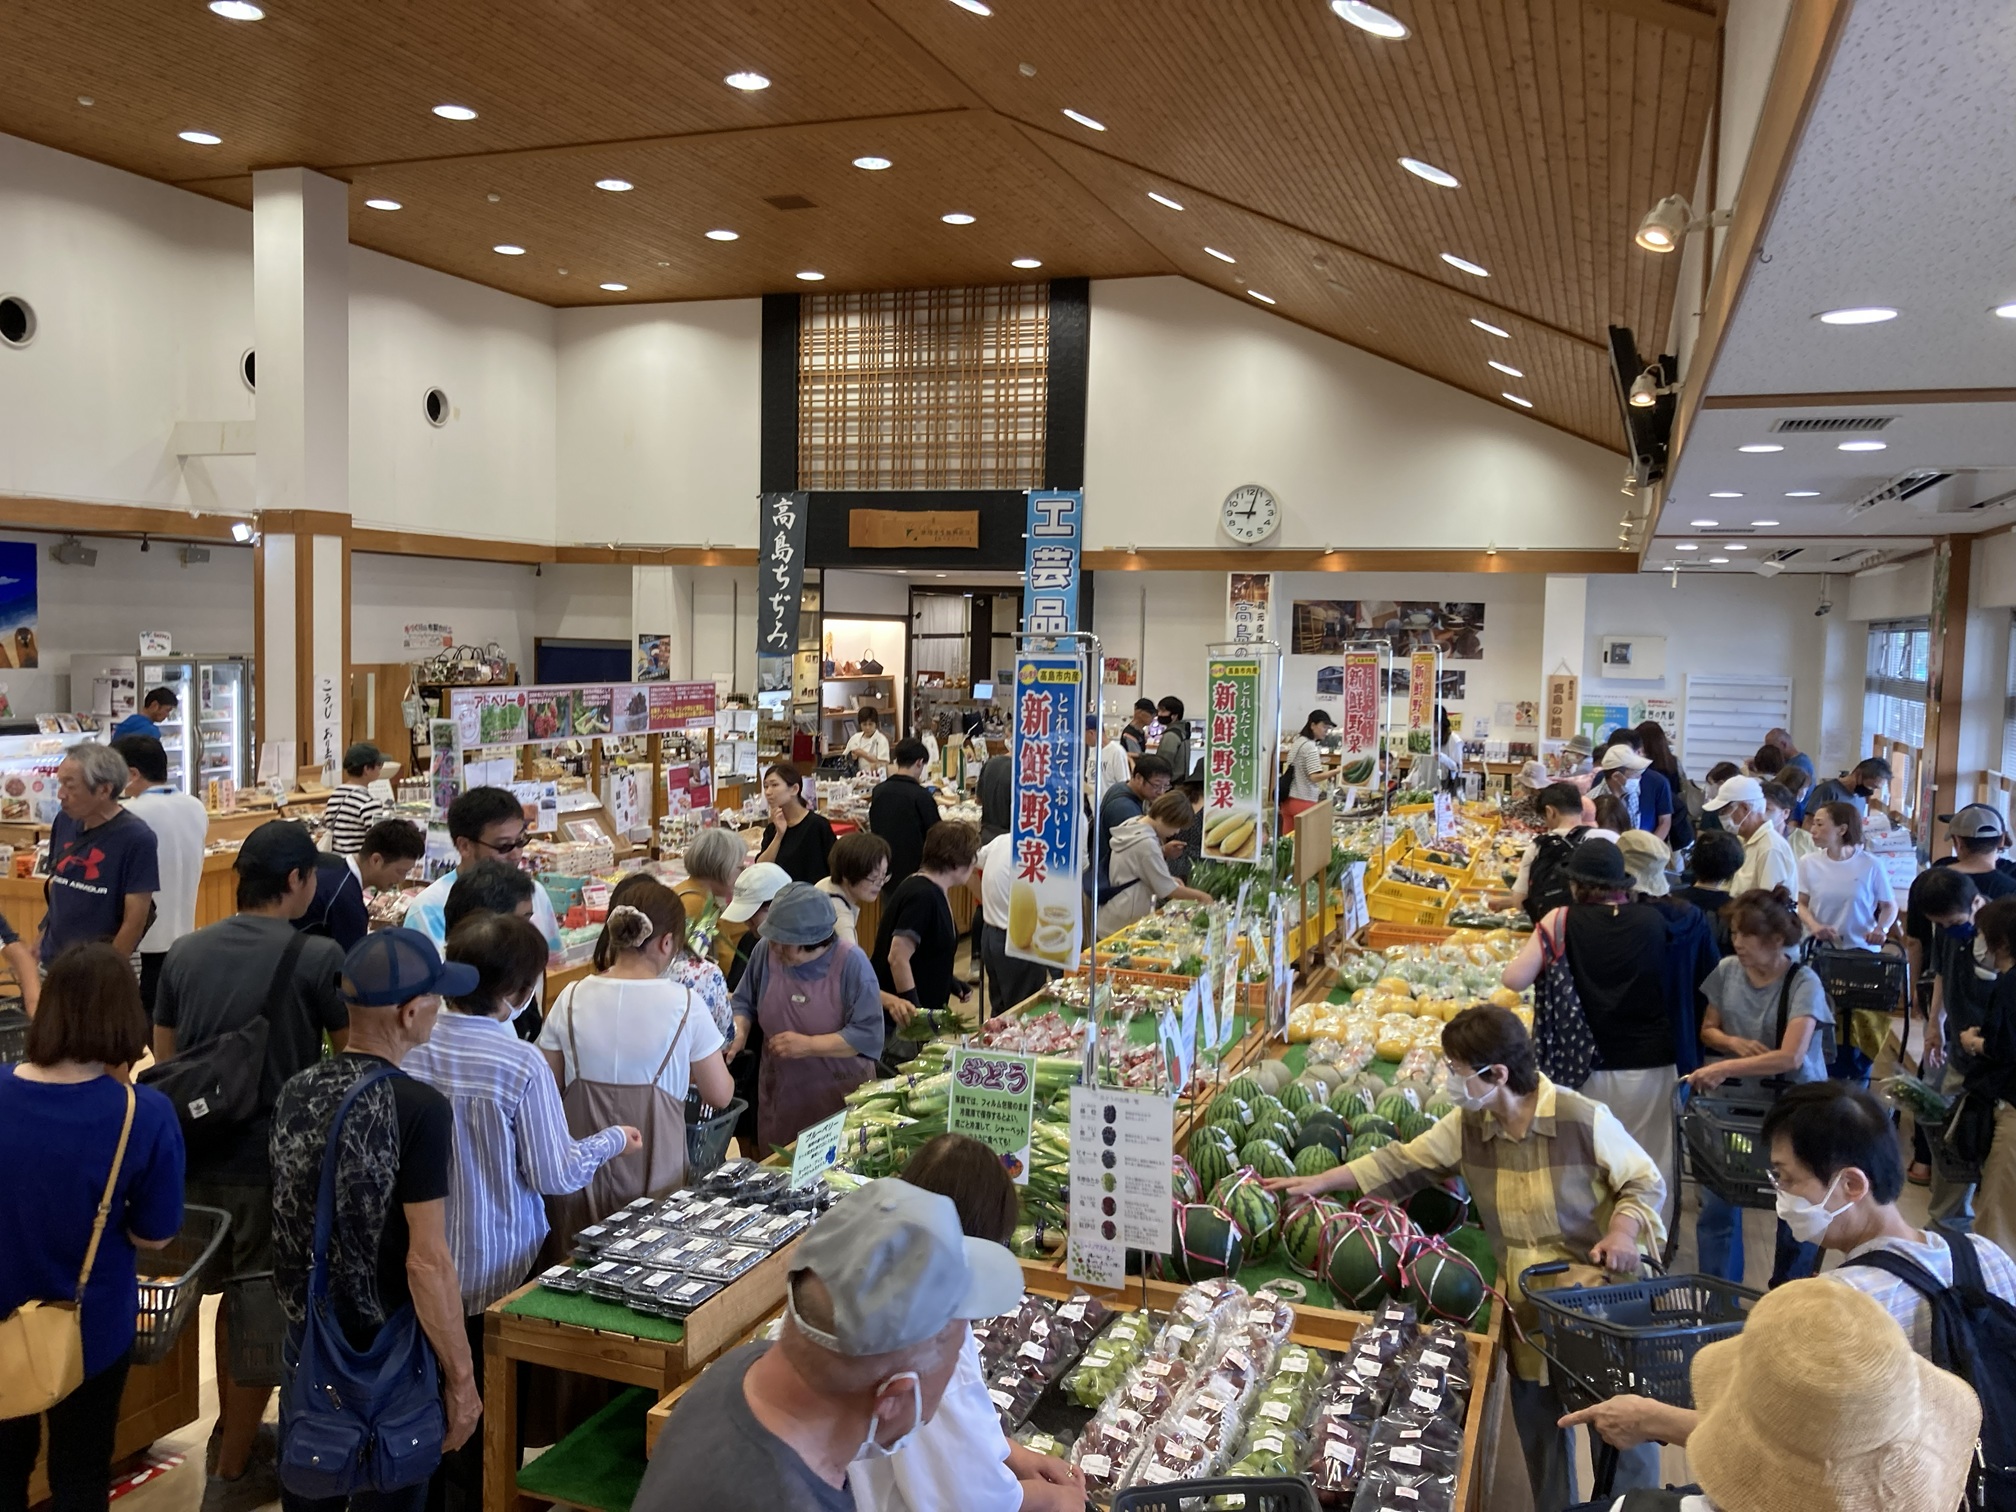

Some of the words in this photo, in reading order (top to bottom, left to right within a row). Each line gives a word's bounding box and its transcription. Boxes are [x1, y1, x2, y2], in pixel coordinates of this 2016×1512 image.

[1229, 500, 1238, 508] 10
[1236, 492, 1244, 500] 11
[1229, 519, 1236, 527] 8
[1267, 509, 1275, 517] 3
[1236, 527, 1243, 535] 7
[1246, 530, 1253, 538] 6
[1256, 527, 1264, 535] 5
[767, 497, 797, 648] 高島ちぢみ
[1029, 498, 1076, 640] 工芸品
[1040, 670, 1080, 682] 高島市内産
[322, 679, 333, 719] こうじ
[474, 694, 516, 709] アドベリー
[1411, 663, 1425, 730] 新鮮野菜
[1347, 667, 1364, 754] 新鮮野菜
[1210, 682, 1236, 810] 新鮮野菜
[1238, 681, 1251, 799] とれたて、おいしい
[1017, 690, 1051, 885] 新鮮野菜
[1052, 692, 1071, 871] とれたて、おいしい
[69, 880, 107, 894] ARMOUR
[956, 1057, 1029, 1094] ぶどう
